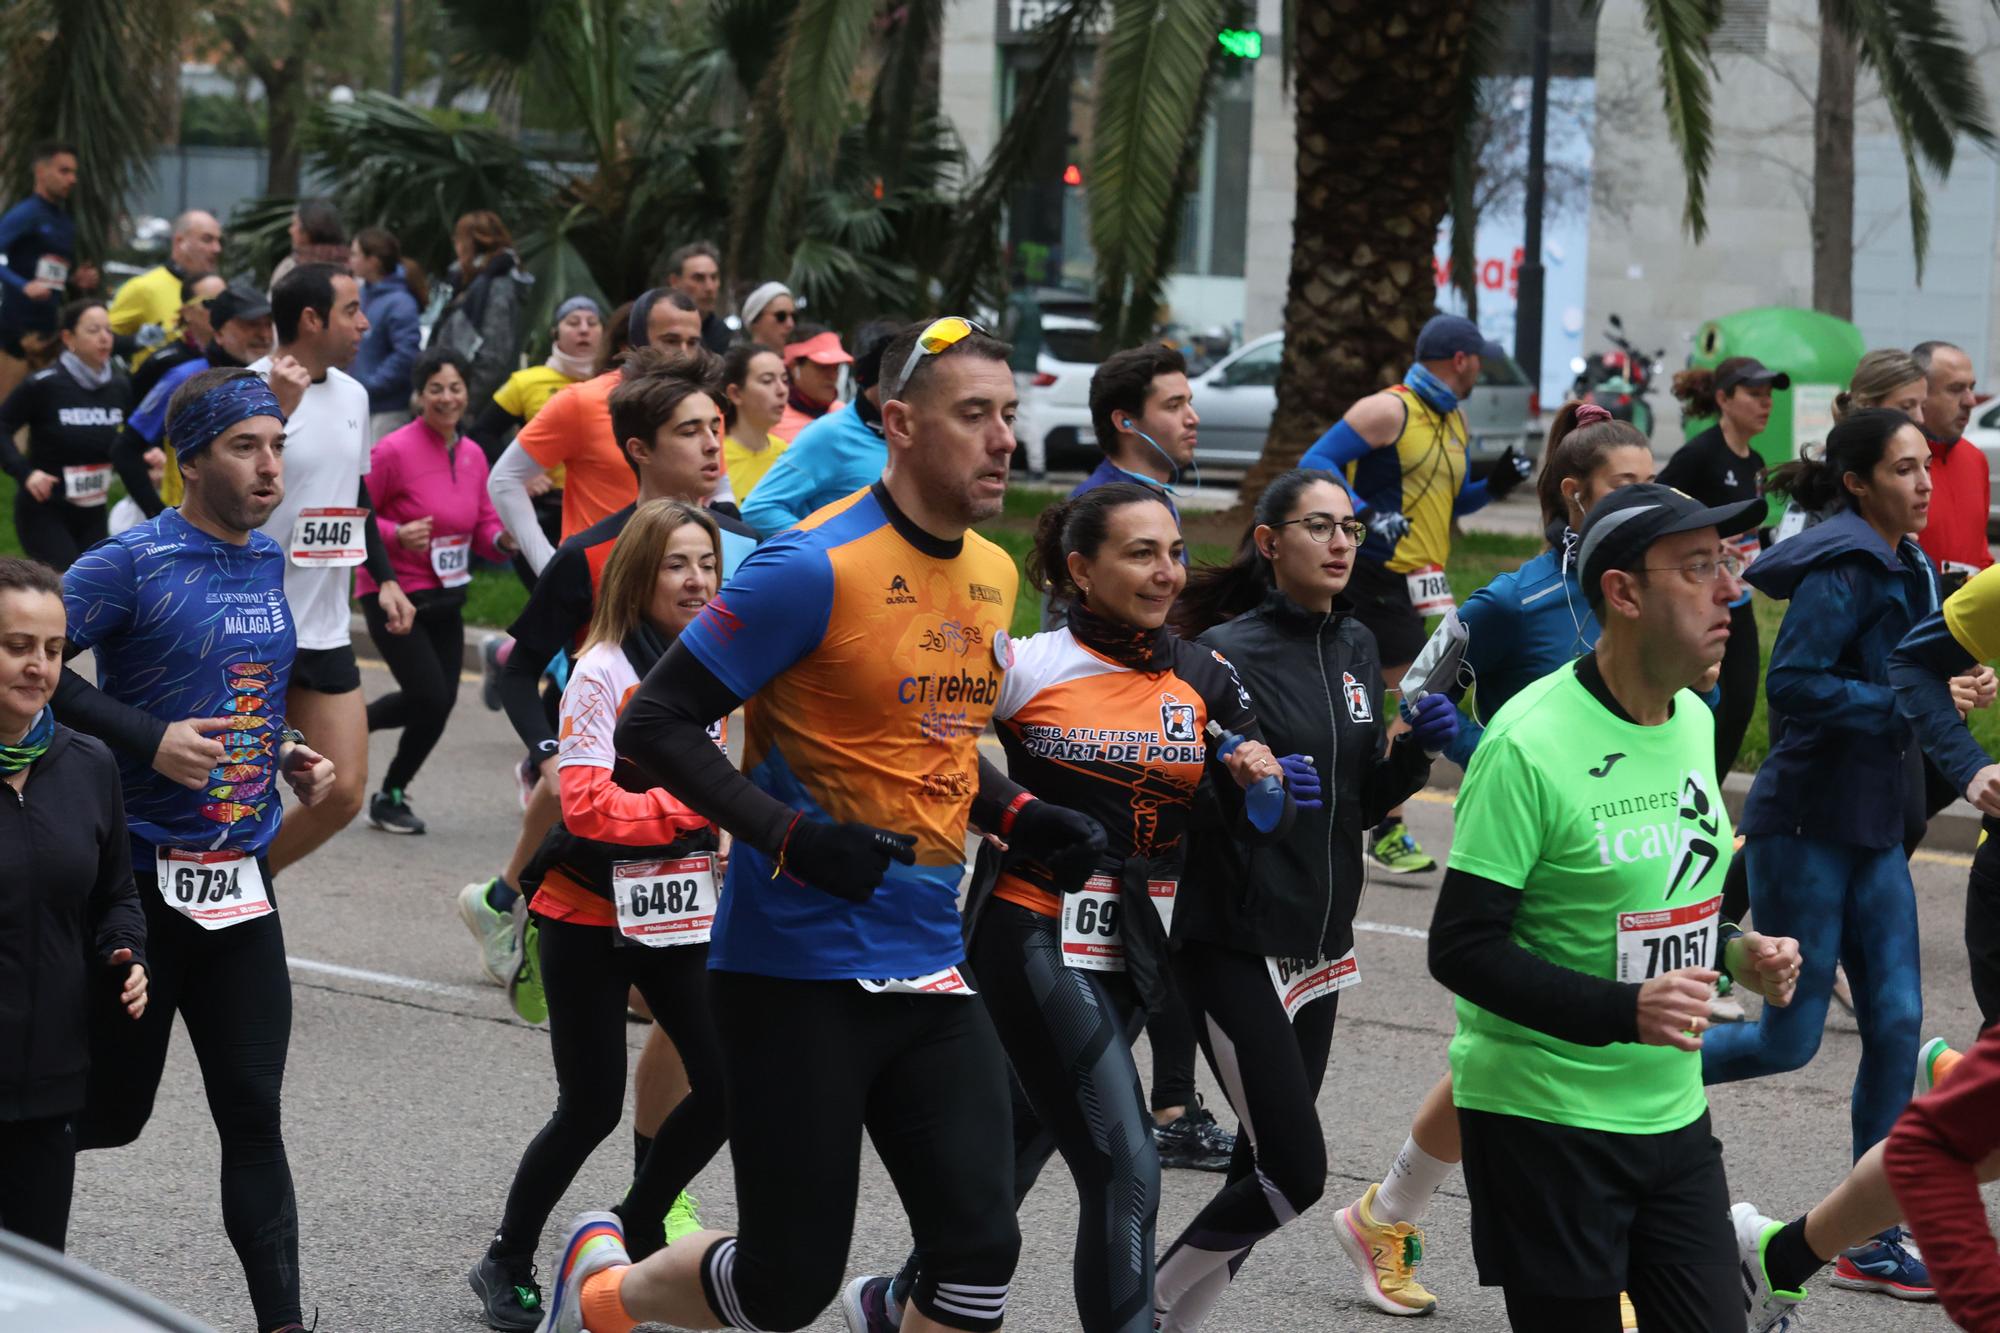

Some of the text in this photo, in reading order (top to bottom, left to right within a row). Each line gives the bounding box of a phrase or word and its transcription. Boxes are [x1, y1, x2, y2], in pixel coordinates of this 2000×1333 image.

[303, 511, 352, 545] 5446
[220, 592, 264, 604] GENERALI
[225, 613, 272, 634] MÁLAGA
[936, 668, 998, 705] rehab
[1023, 724, 1160, 743] CLUB ATLETISME
[1023, 737, 1100, 762] QUART
[1105, 744, 1140, 763] DE
[1591, 791, 1679, 821] runners
[1595, 821, 1681, 865] icav
[175, 867, 242, 904] 6734
[630, 879, 699, 917] 6482
[1642, 926, 1709, 980] 7057
